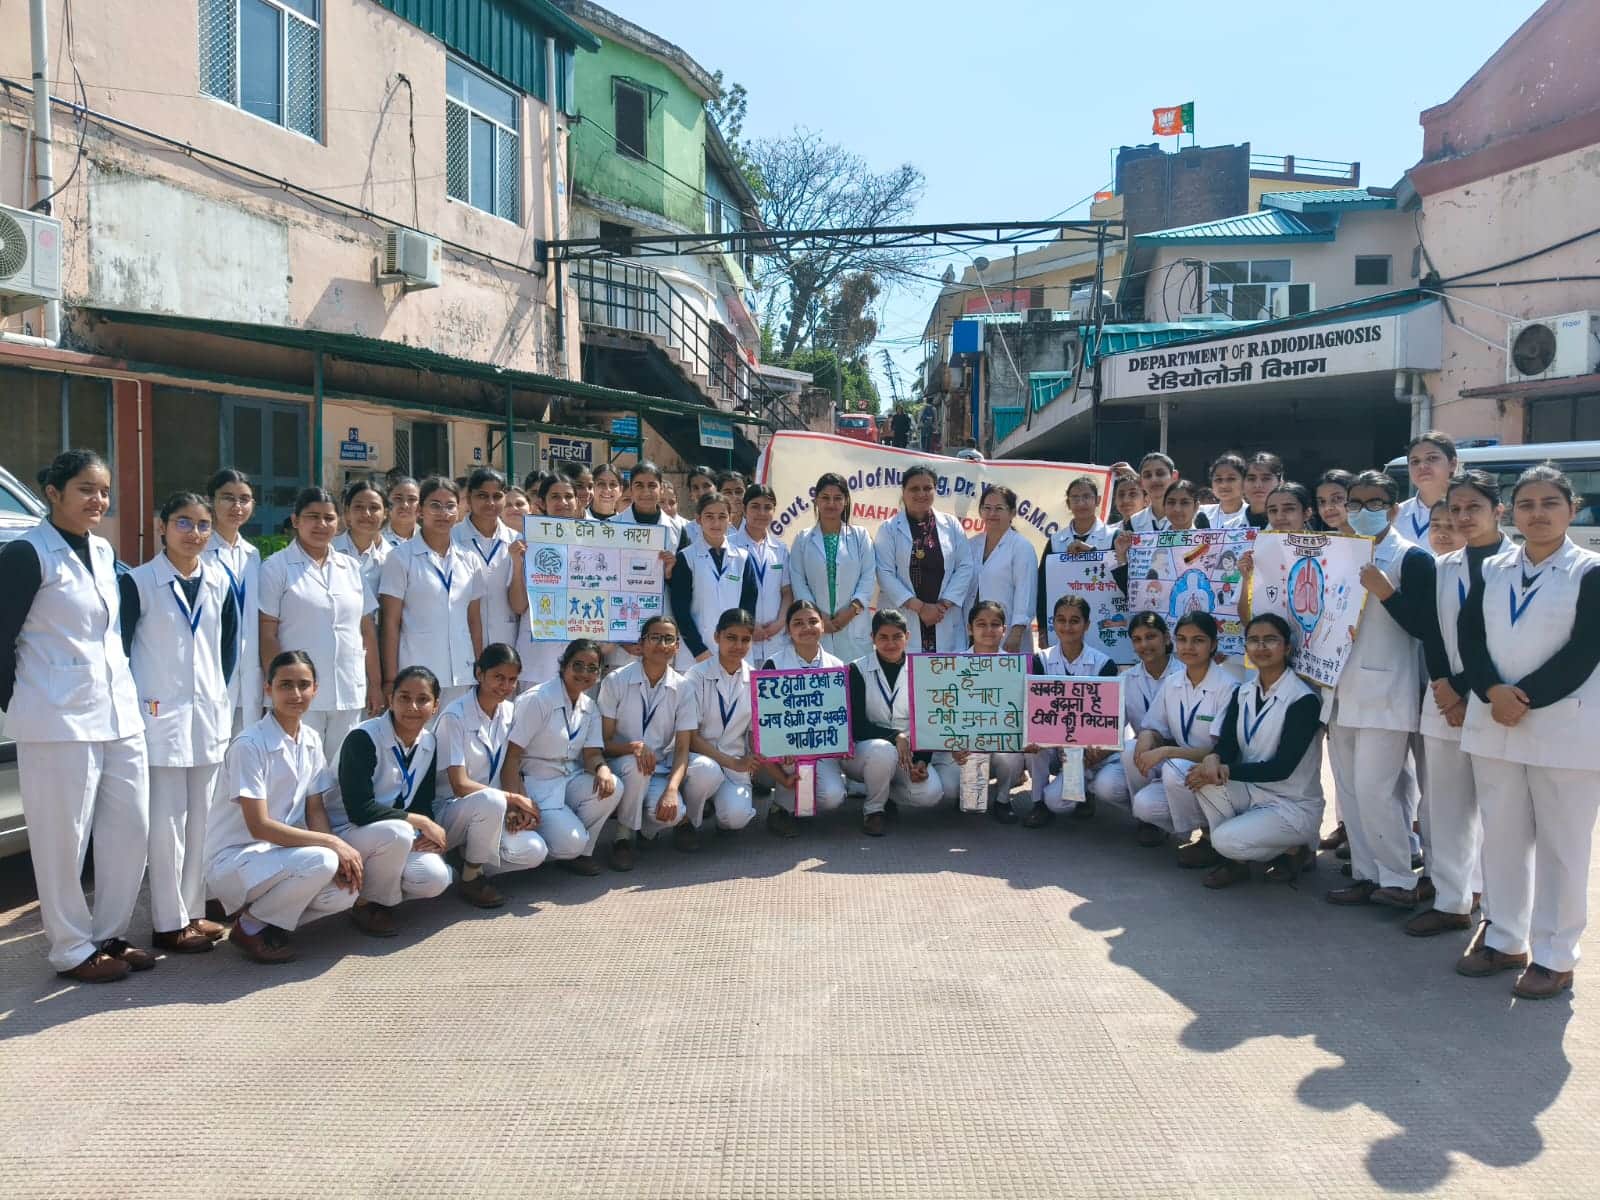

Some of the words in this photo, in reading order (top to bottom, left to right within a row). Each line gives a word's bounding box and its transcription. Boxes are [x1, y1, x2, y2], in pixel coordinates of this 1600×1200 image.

[1128, 346, 1229, 372] DEPARTMENT
[1231, 343, 1246, 360] OF
[1247, 325, 1383, 356] RADIODIAGNOSIS
[1147, 362, 1253, 391] रेडियोलोजी
[1260, 355, 1328, 380] विभाग
[770, 495, 809, 537] Govt.
[865, 466, 882, 487] of
[954, 476, 976, 497] Dr.
[600, 522, 615, 539] के
[928, 655, 957, 675] हम
[963, 655, 992, 673] सब
[998, 655, 1021, 672] का
[783, 690, 825, 709] बीमारी
[927, 682, 959, 707] यही
[967, 687, 1004, 707] नारा
[759, 712, 782, 729] जब
[928, 707, 959, 725] टीबी
[1003, 701, 1024, 729] हो
[1031, 708, 1059, 726] टीबी
[1080, 712, 1119, 730] मिटाना
[786, 726, 838, 749] भागीदारी
[974, 732, 1024, 752] हमारा
